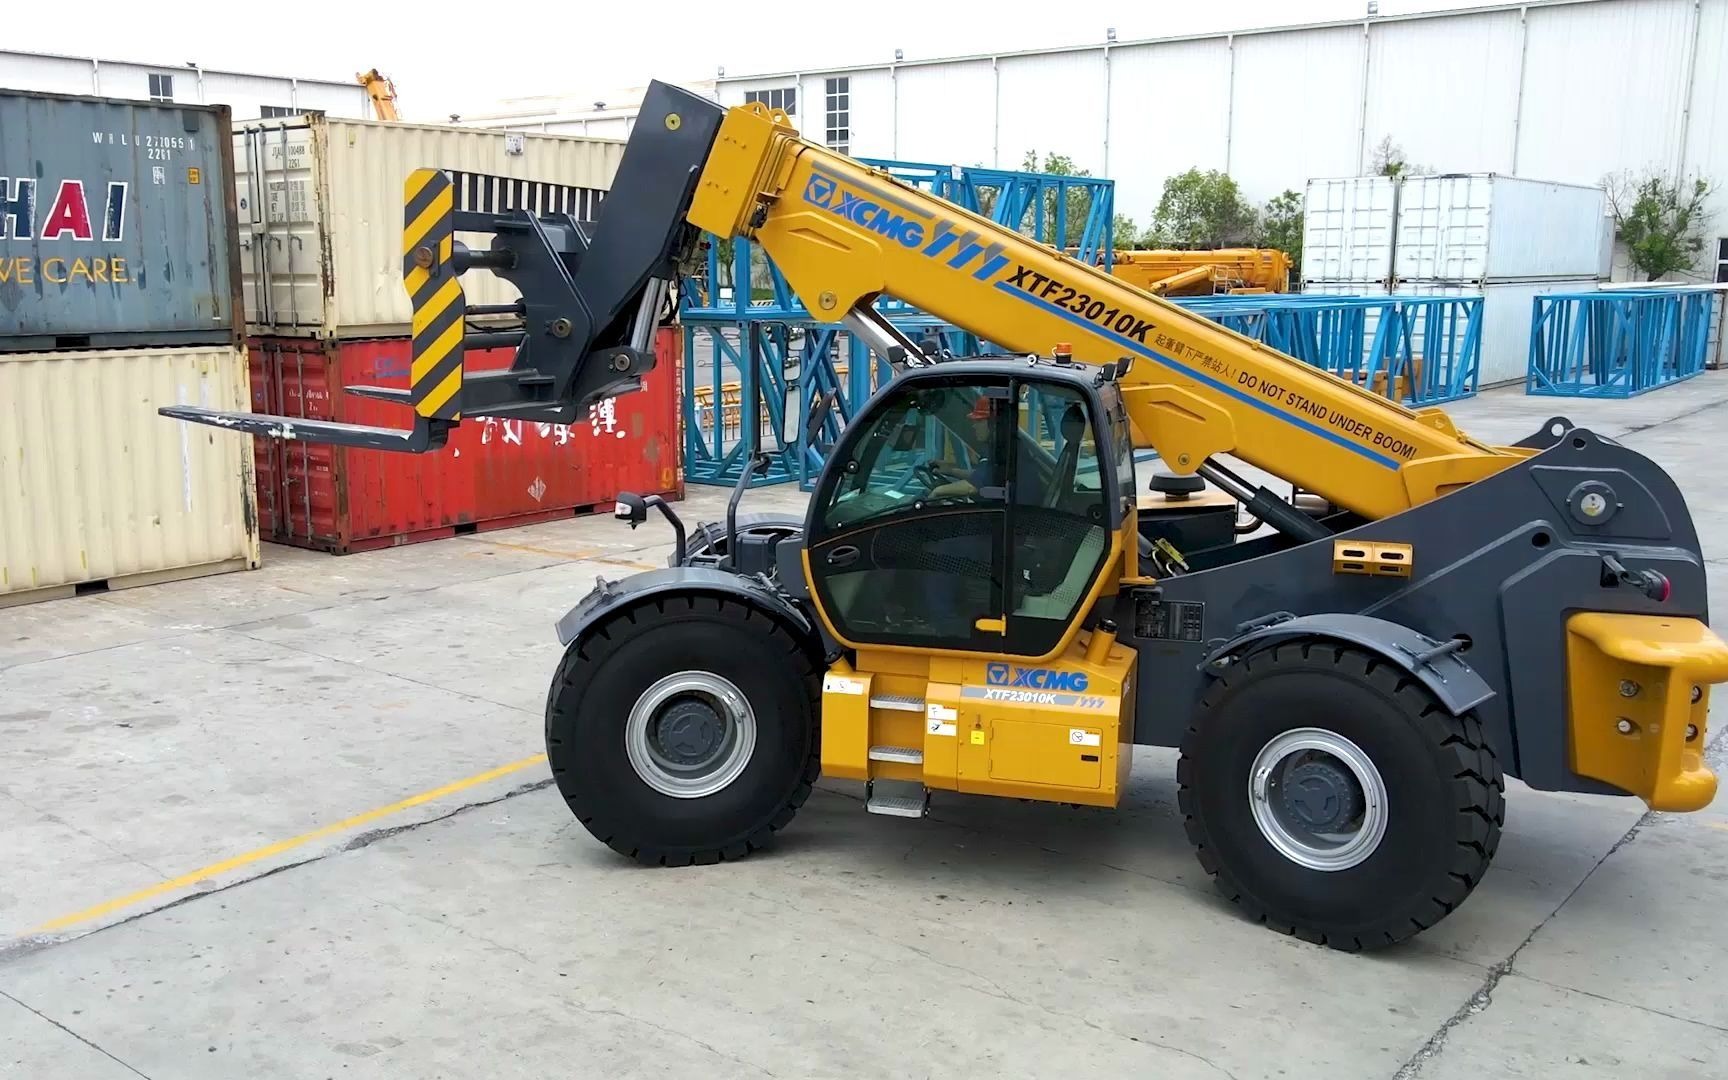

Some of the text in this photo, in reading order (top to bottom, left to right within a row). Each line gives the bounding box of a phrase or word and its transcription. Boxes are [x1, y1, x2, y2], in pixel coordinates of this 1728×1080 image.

[0, 177, 128, 241] HAI
[831, 190, 924, 248] XCMG
[43, 257, 137, 283] CARE.
[1006, 265, 1156, 344] XTF23010K
[1238, 371, 1418, 460] DO NOT STAND UNDER BOOM!
[984, 689, 1057, 705] XTF23010K
[1010, 667, 1089, 692] XCMG
